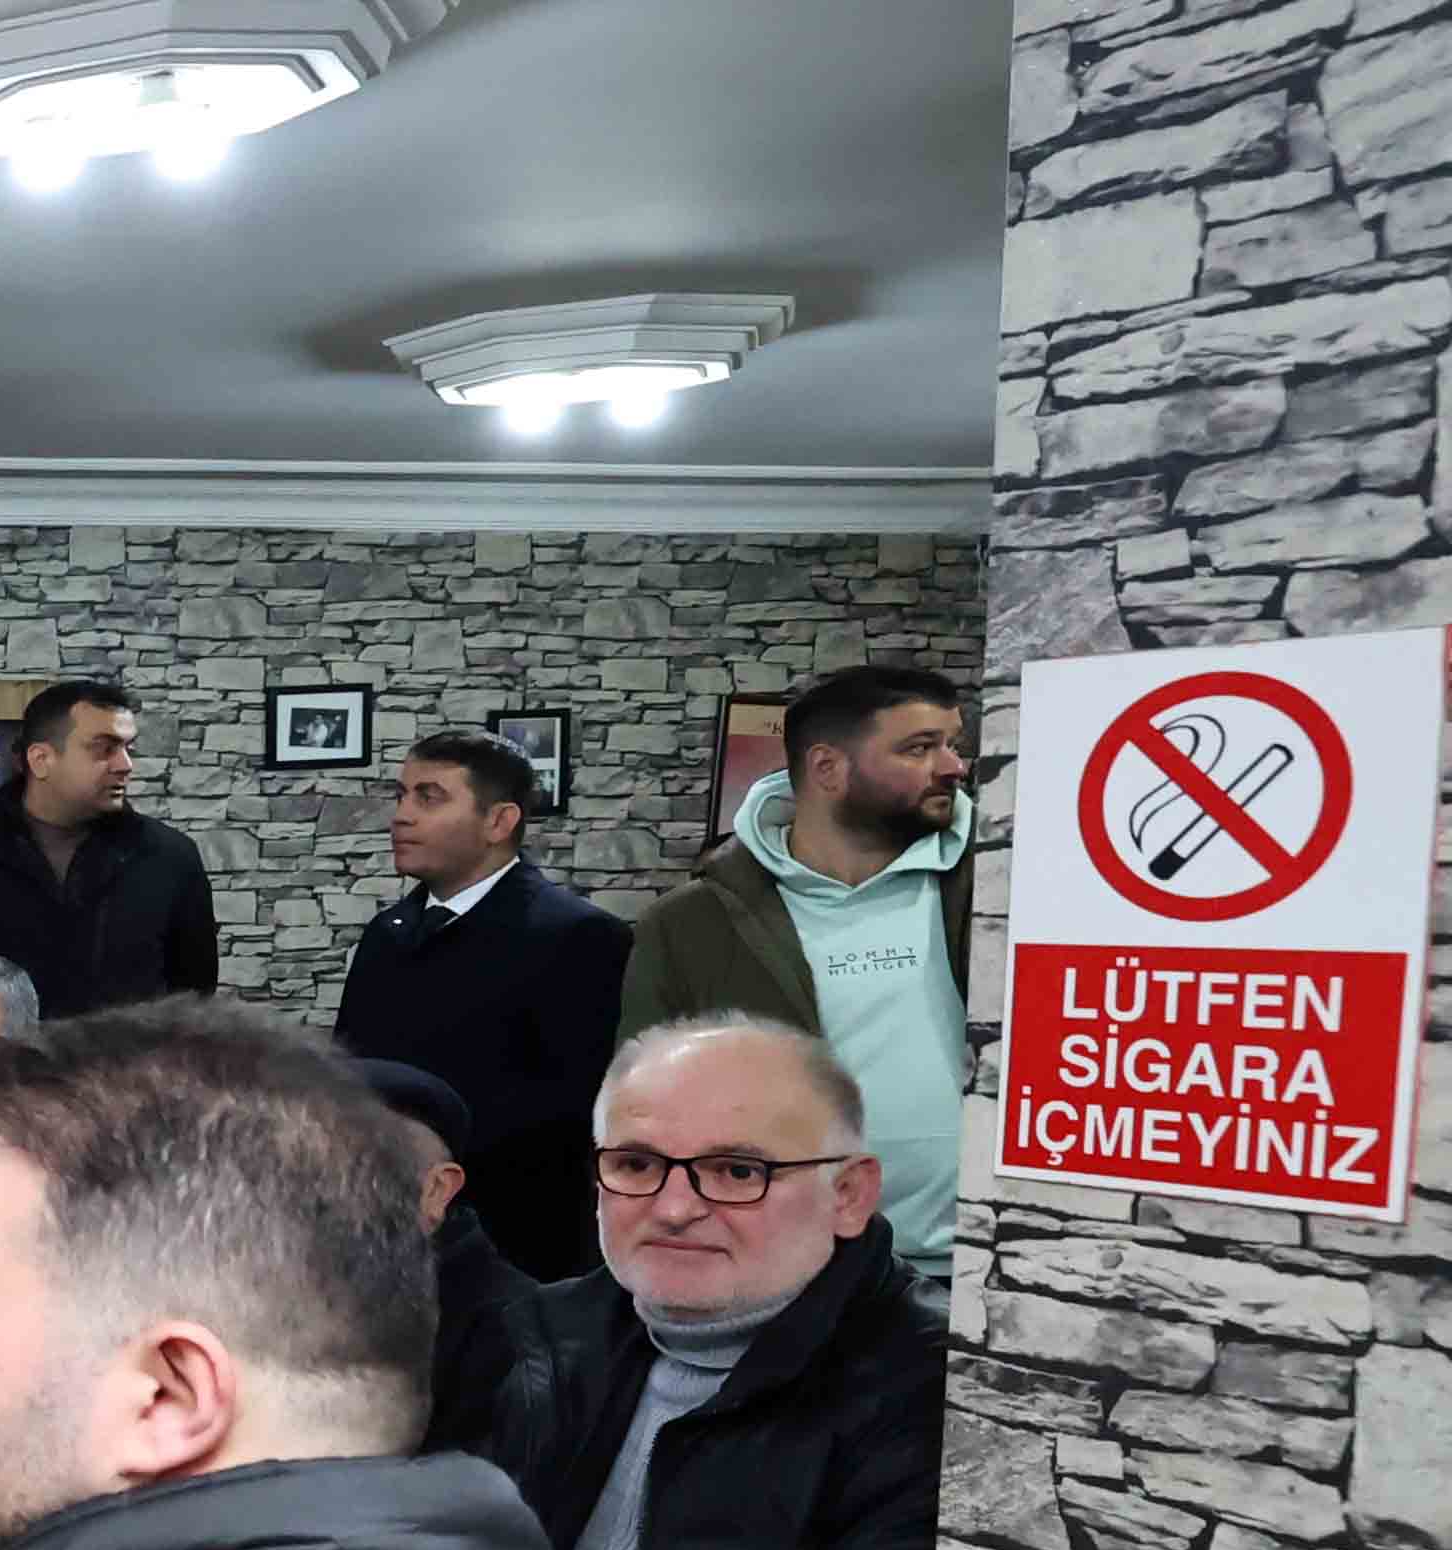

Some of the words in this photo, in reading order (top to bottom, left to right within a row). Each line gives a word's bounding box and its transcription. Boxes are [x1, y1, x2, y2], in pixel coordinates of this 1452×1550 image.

[828, 946, 915, 963] TOMMY
[1062, 957, 1343, 1032] LÜTFEN
[1059, 1024, 1335, 1106] SİGARA
[1017, 1085, 1380, 1185] İÇMEYİNİZ
